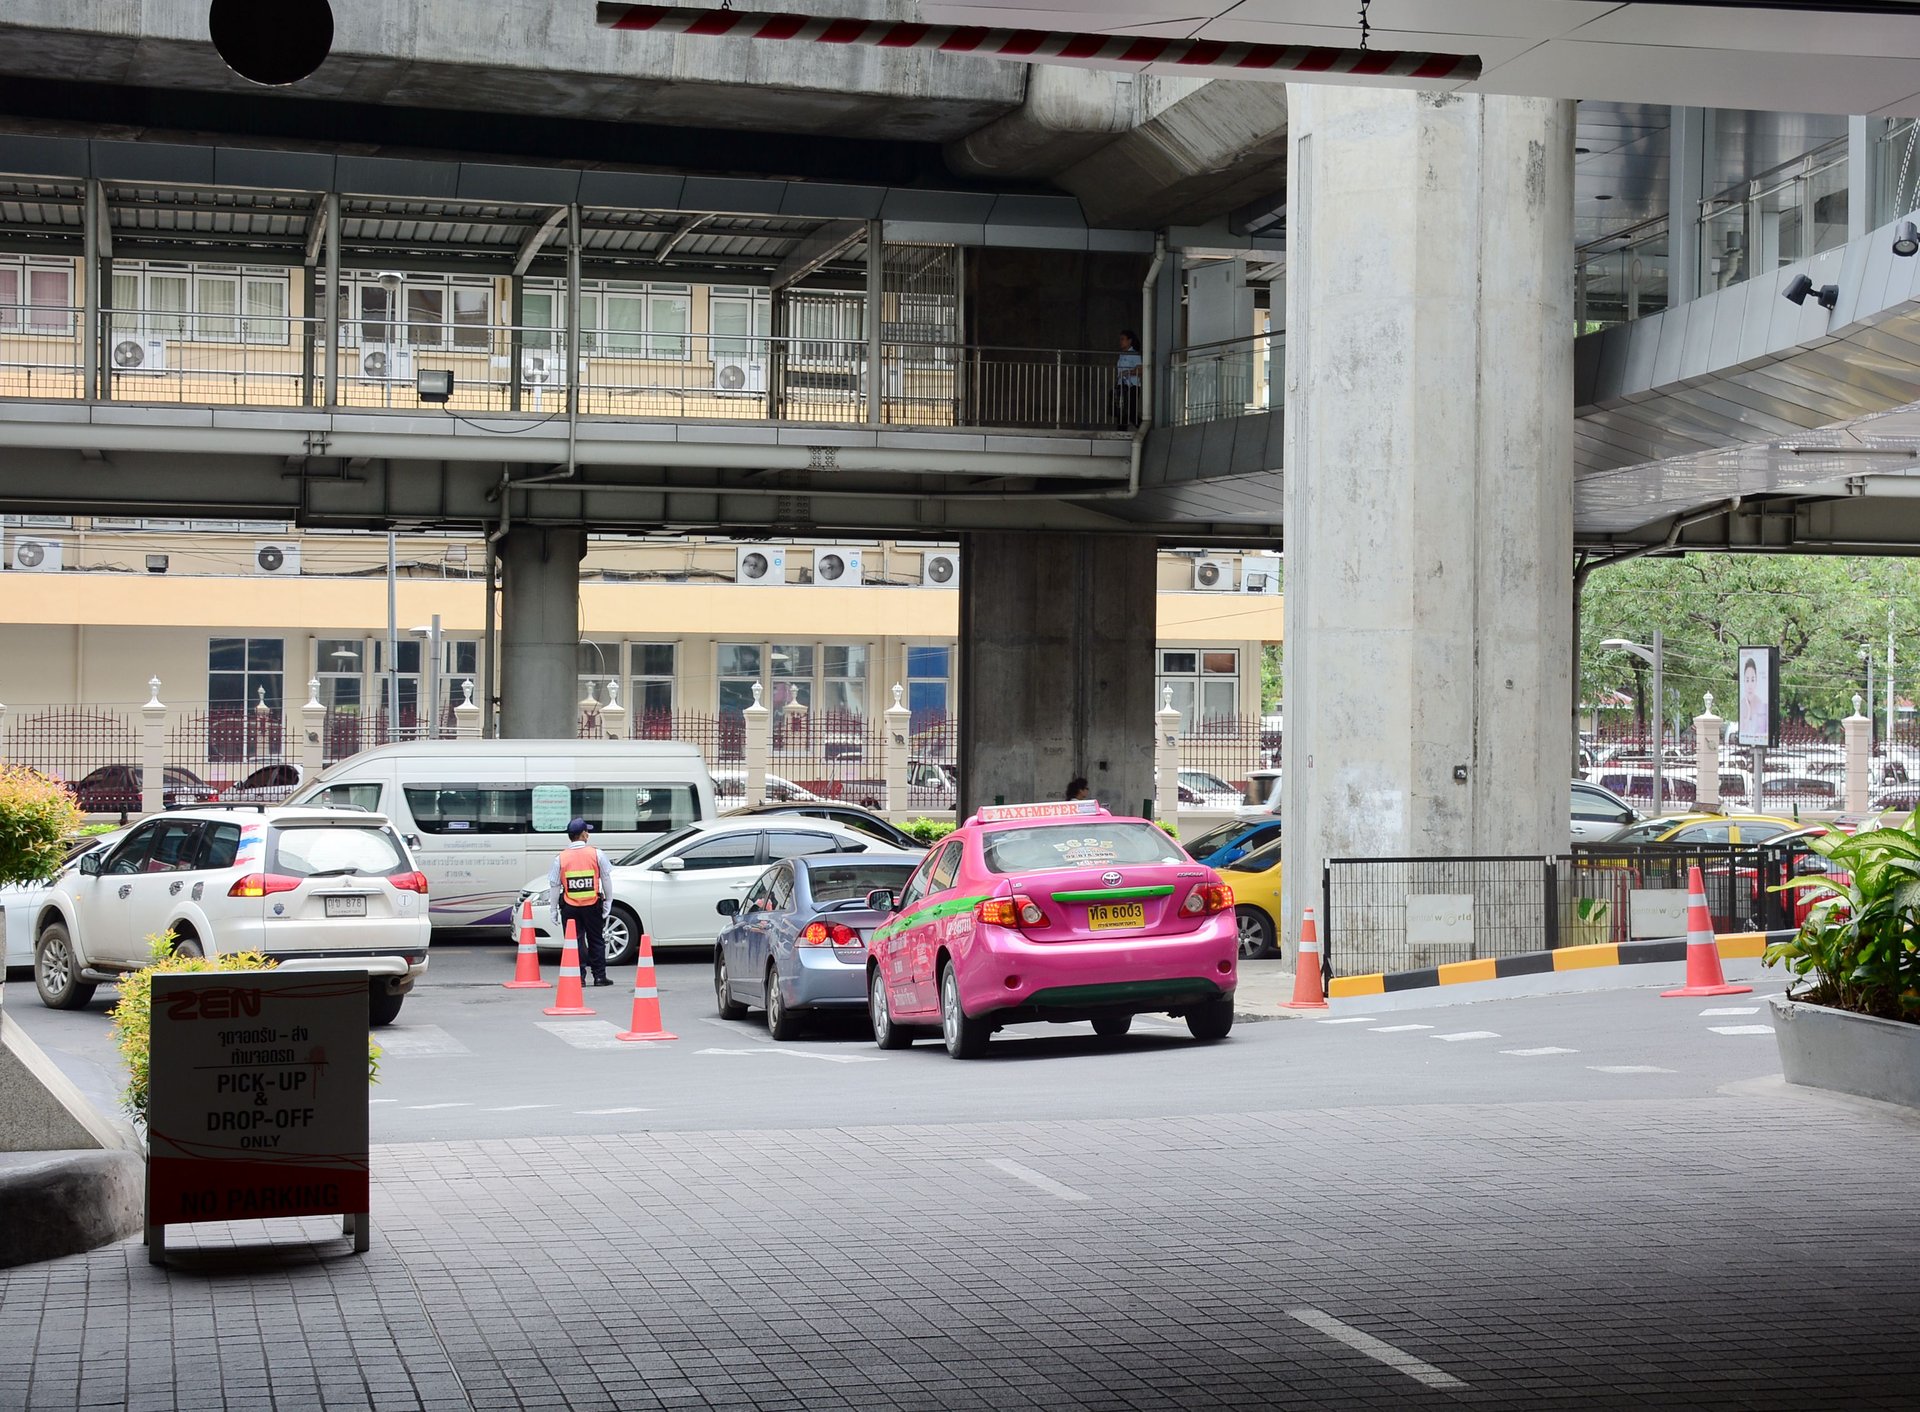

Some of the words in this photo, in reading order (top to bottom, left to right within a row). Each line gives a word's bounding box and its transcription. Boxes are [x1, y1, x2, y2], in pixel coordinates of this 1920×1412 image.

[996, 802, 1079, 820] TAXI-METER
[568, 878, 594, 890] RGH
[346, 897, 362, 908] 878
[1111, 904, 1142, 919] 6003
[167, 988, 262, 1021] ZEN
[231, 1048, 295, 1065] ห้ามจอดรถ
[253, 1091, 268, 1107] &
[207, 1108, 315, 1131] DROP-OFF
[240, 1134, 281, 1149] ONLY
[180, 1189, 218, 1216] NO
[227, 1182, 342, 1214] PARKING
